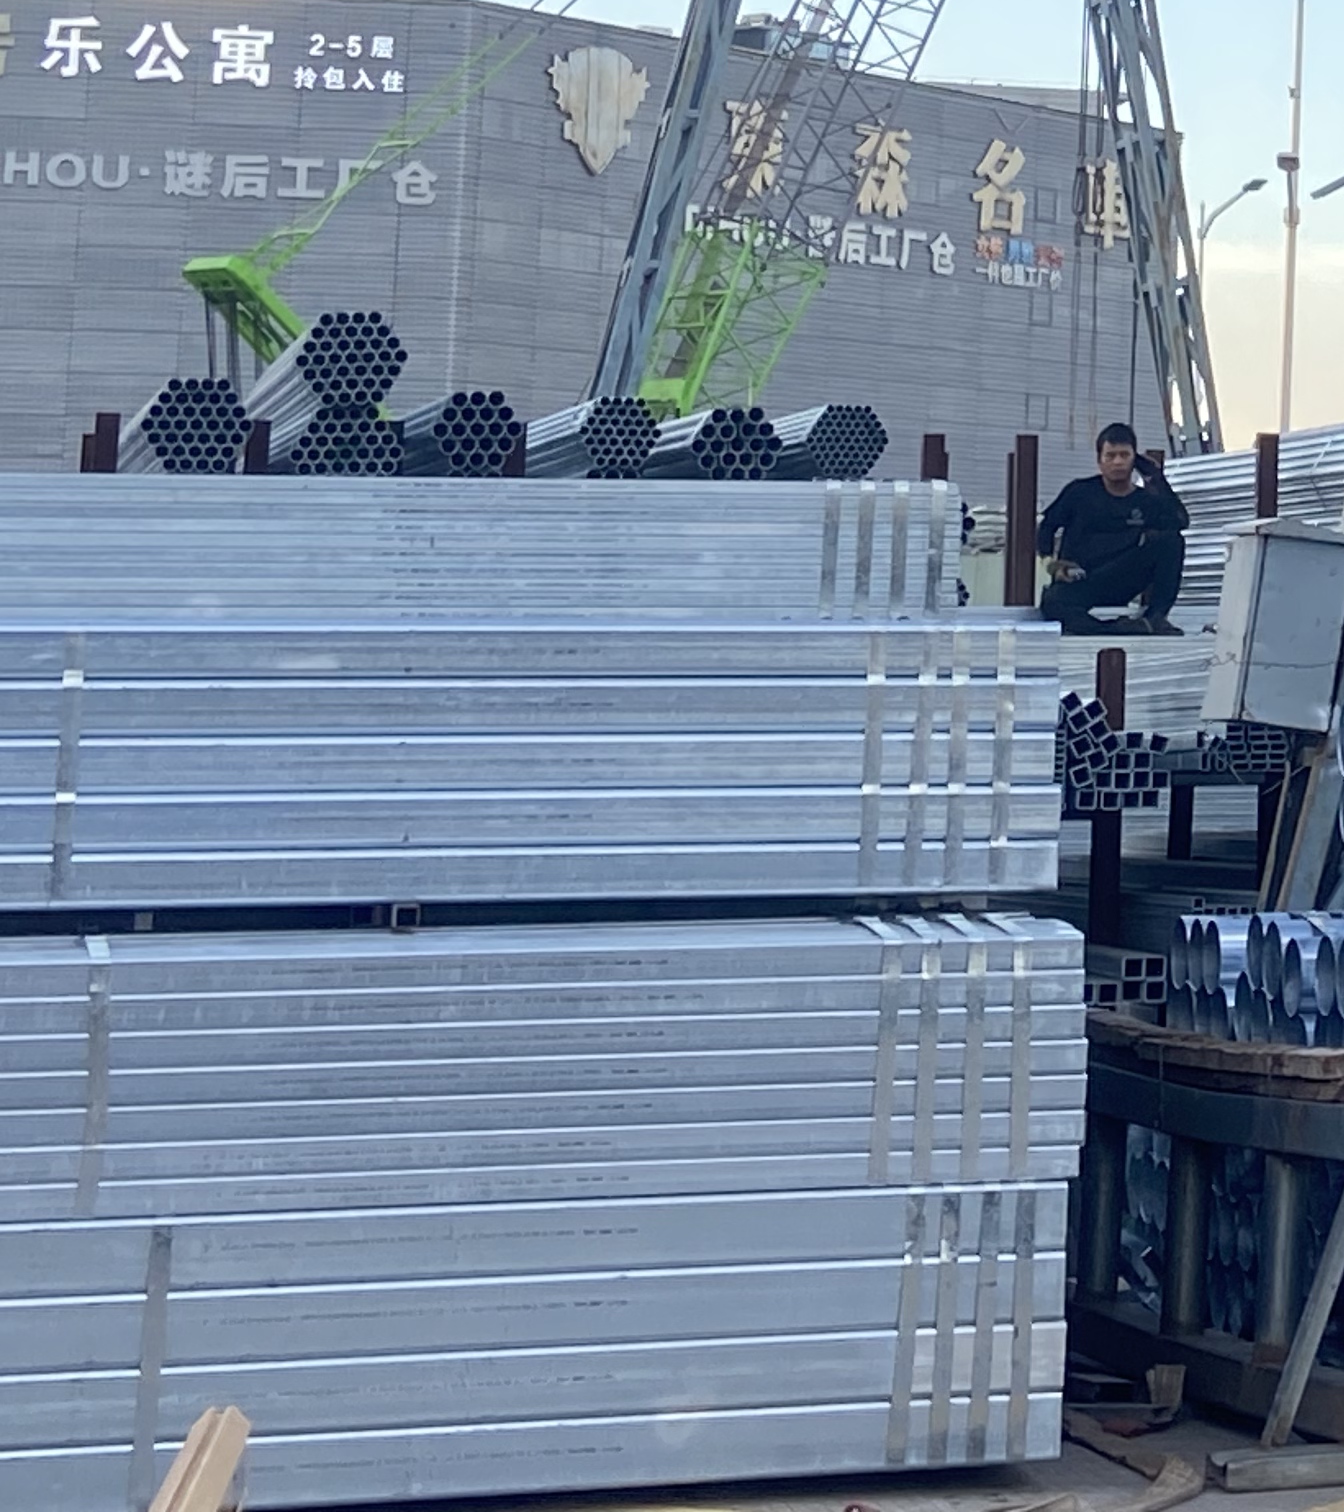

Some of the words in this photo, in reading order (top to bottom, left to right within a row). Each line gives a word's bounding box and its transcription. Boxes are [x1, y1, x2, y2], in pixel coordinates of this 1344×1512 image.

[40, 15, 275, 88] 乐公寓
[293, 65, 405, 94] 拎包入住
